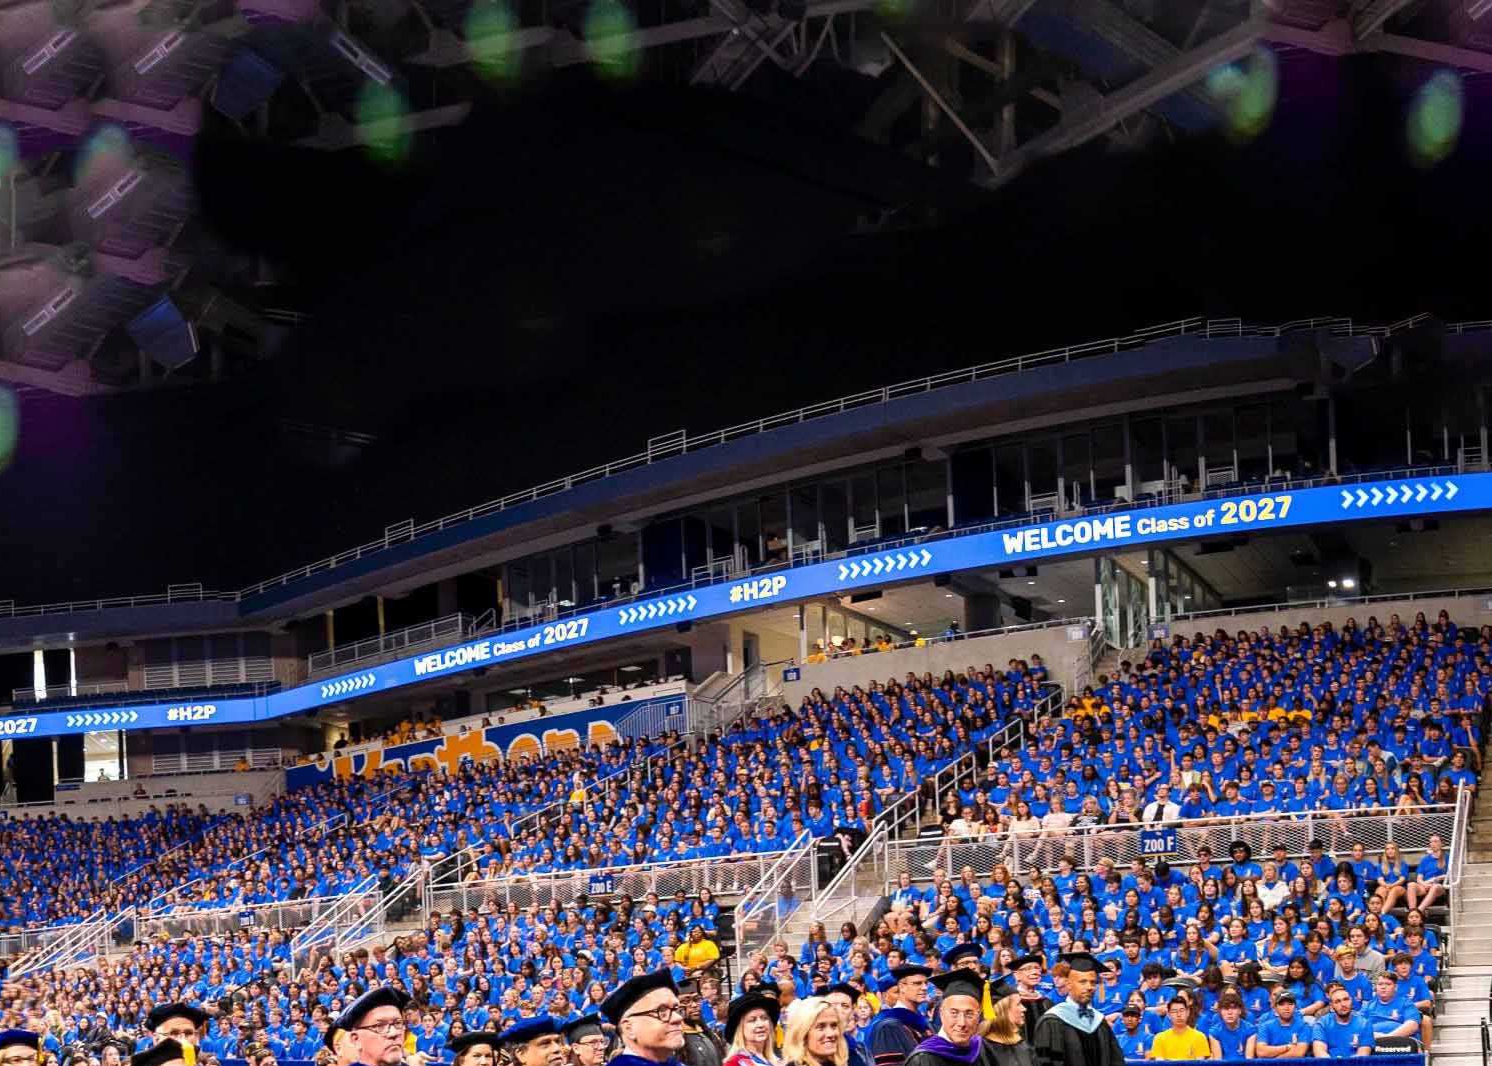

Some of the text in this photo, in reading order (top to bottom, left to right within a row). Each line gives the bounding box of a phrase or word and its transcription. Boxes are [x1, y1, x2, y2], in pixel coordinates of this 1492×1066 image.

[1002, 495, 1293, 555] WELCOME Class of 2027
[728, 575, 787, 603] #H2P
[413, 617, 590, 677] WELCOME Class of 2027
[167, 704, 218, 722] #H2P
[1167, 836, 1175, 851] F
[606, 880, 612, 893] E
